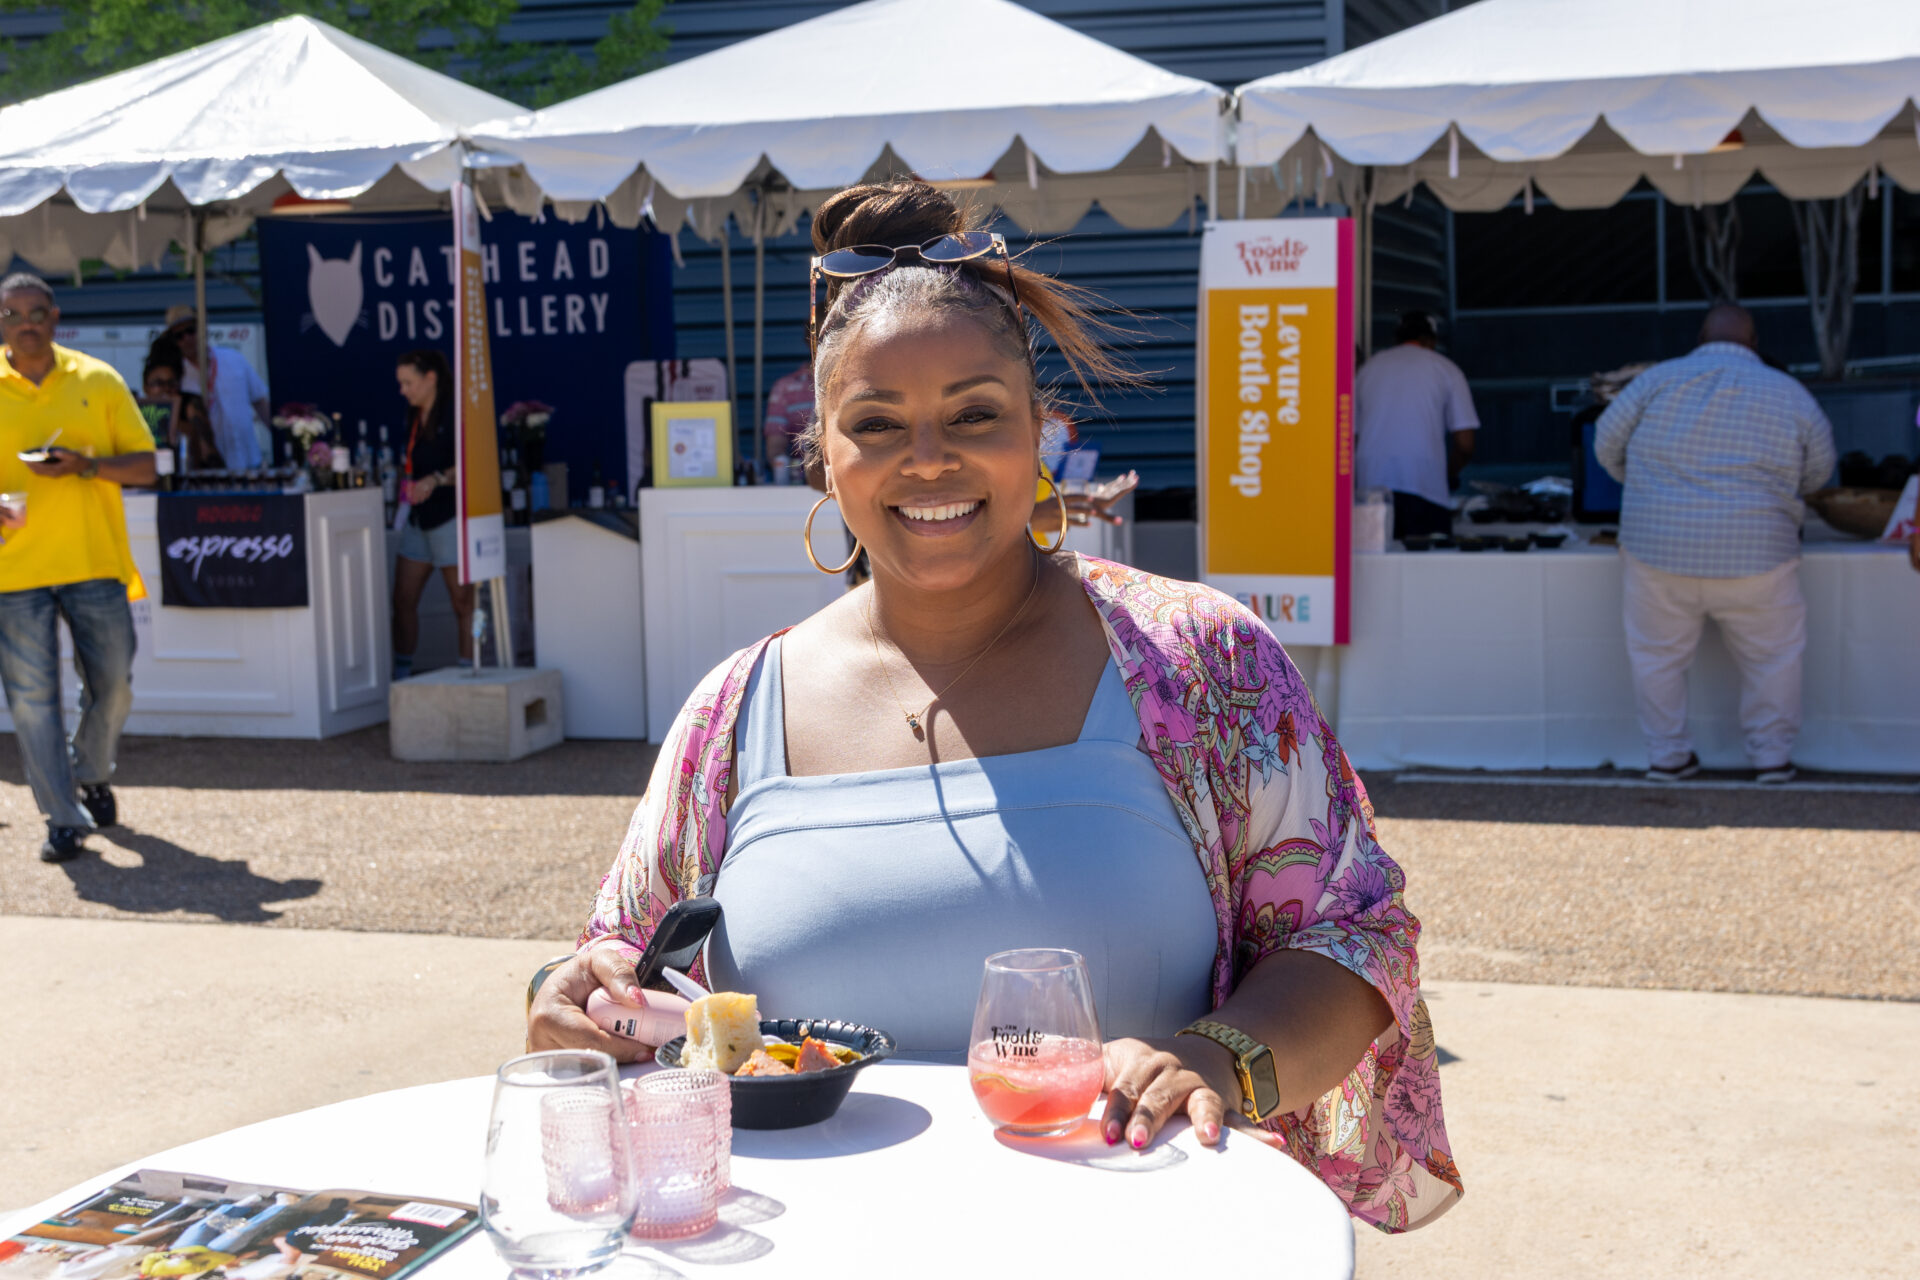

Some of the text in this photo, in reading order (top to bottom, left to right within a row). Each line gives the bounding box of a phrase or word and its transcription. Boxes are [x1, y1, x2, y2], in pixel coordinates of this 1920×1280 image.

[374, 239, 610, 287] CATHEAD
[1243, 258, 1301, 276] Wine
[378, 293, 609, 340] DISLLERY
[1277, 303, 1308, 425] Levure
[1230, 305, 1271, 497] Bottle Shop
[166, 532, 294, 582] espresso
[991, 1026, 1044, 1045] Food&
[995, 1042, 1038, 1058] Wine
